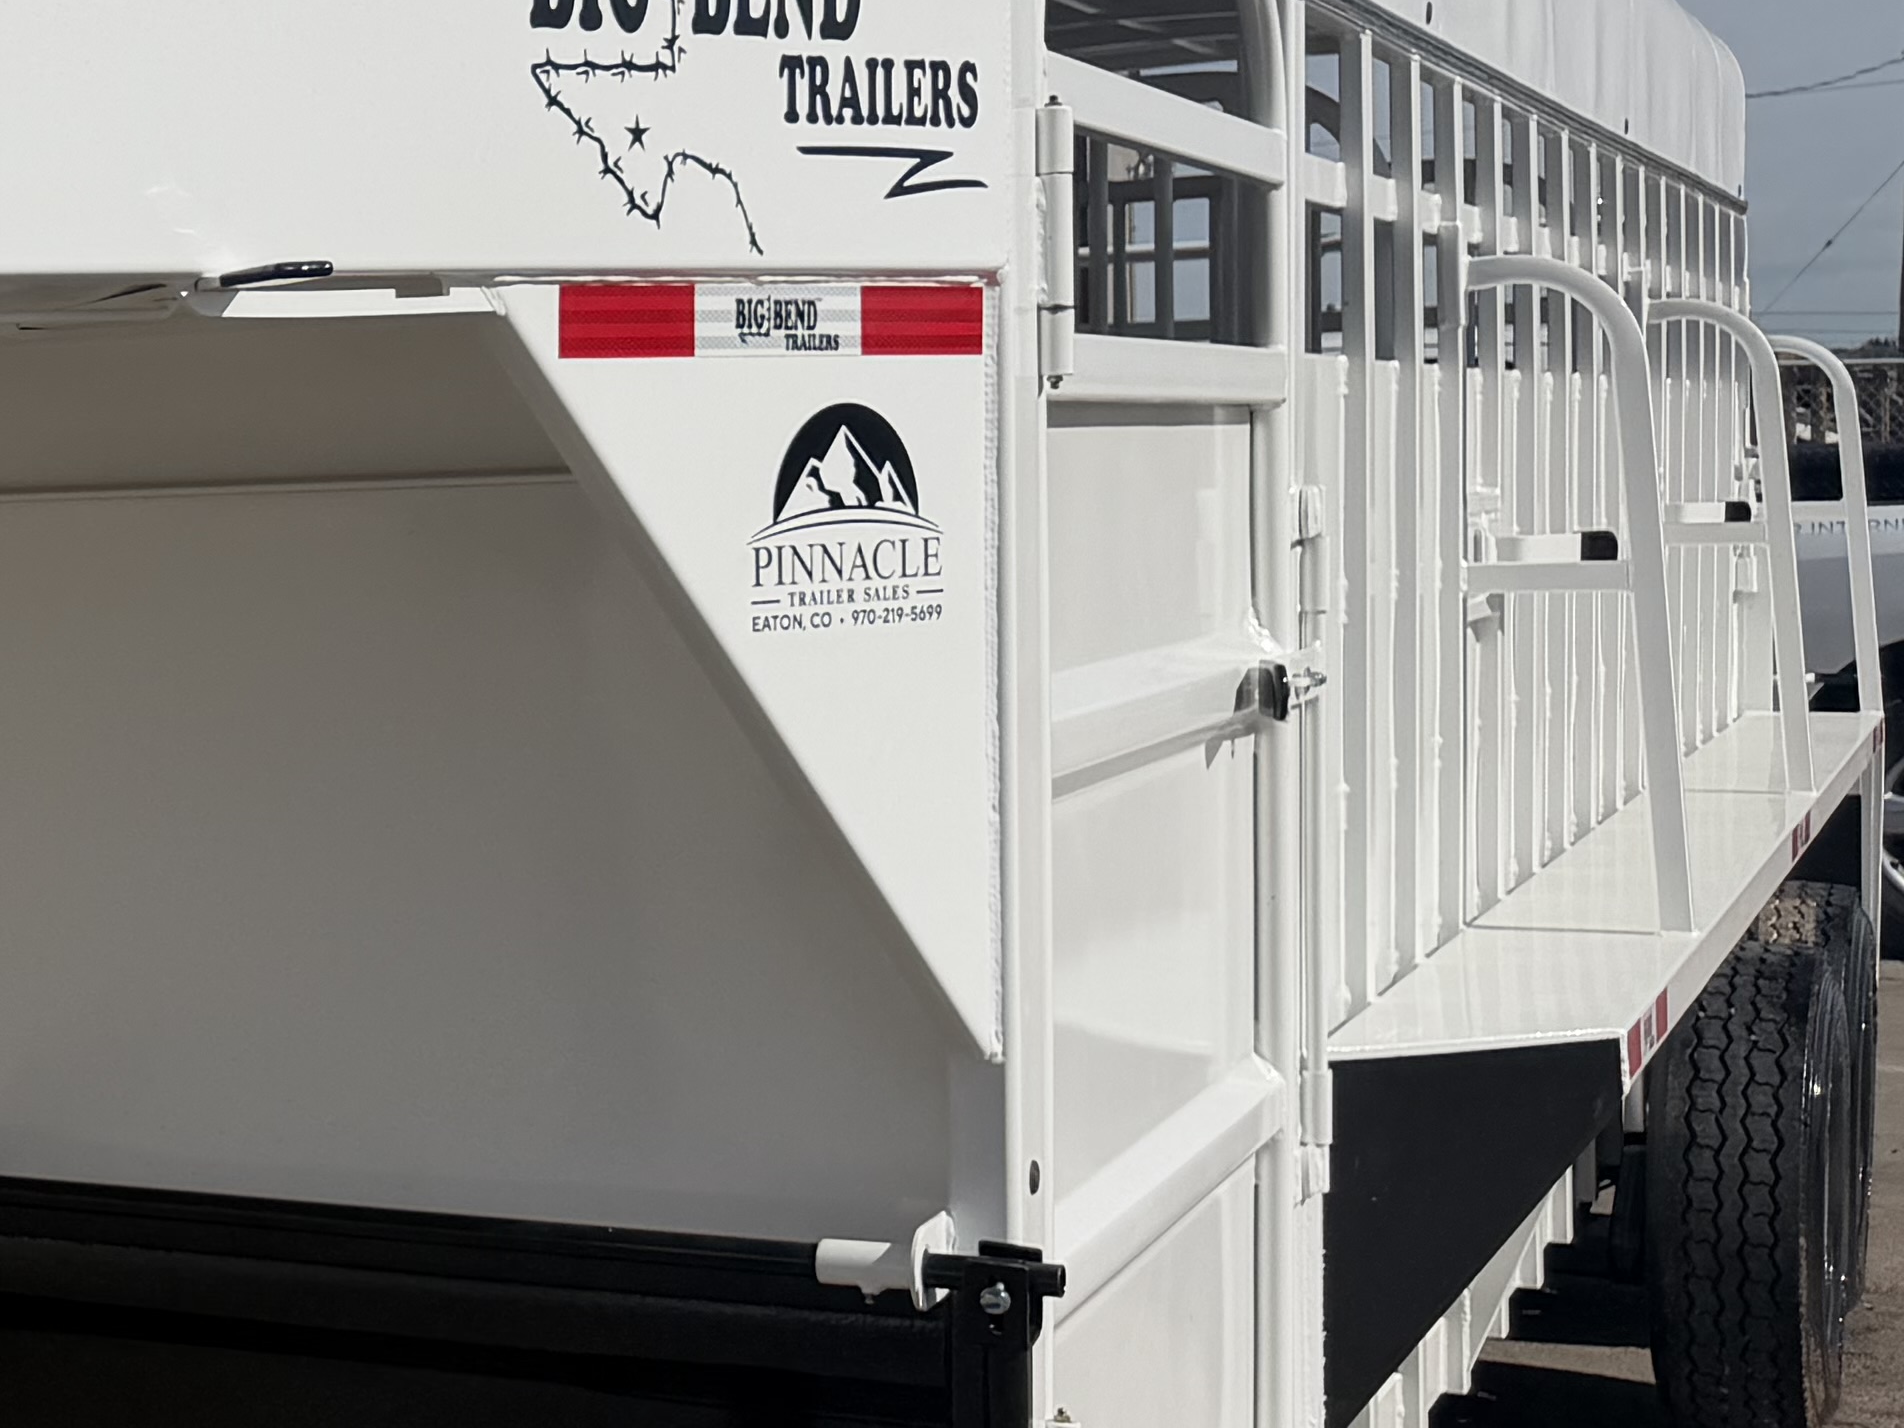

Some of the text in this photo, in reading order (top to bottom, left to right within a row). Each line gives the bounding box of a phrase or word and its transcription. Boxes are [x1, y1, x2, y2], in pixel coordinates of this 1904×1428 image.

[778, 53, 980, 129] TRAILERS
[735, 298, 818, 331] BIG BEND
[784, 333, 840, 351] TRAILERS
[752, 536, 943, 588] PINNACLE
[787, 584, 911, 608] TRAILER SALES
[752, 603, 943, 633] EATON, CO 970-219-5699
